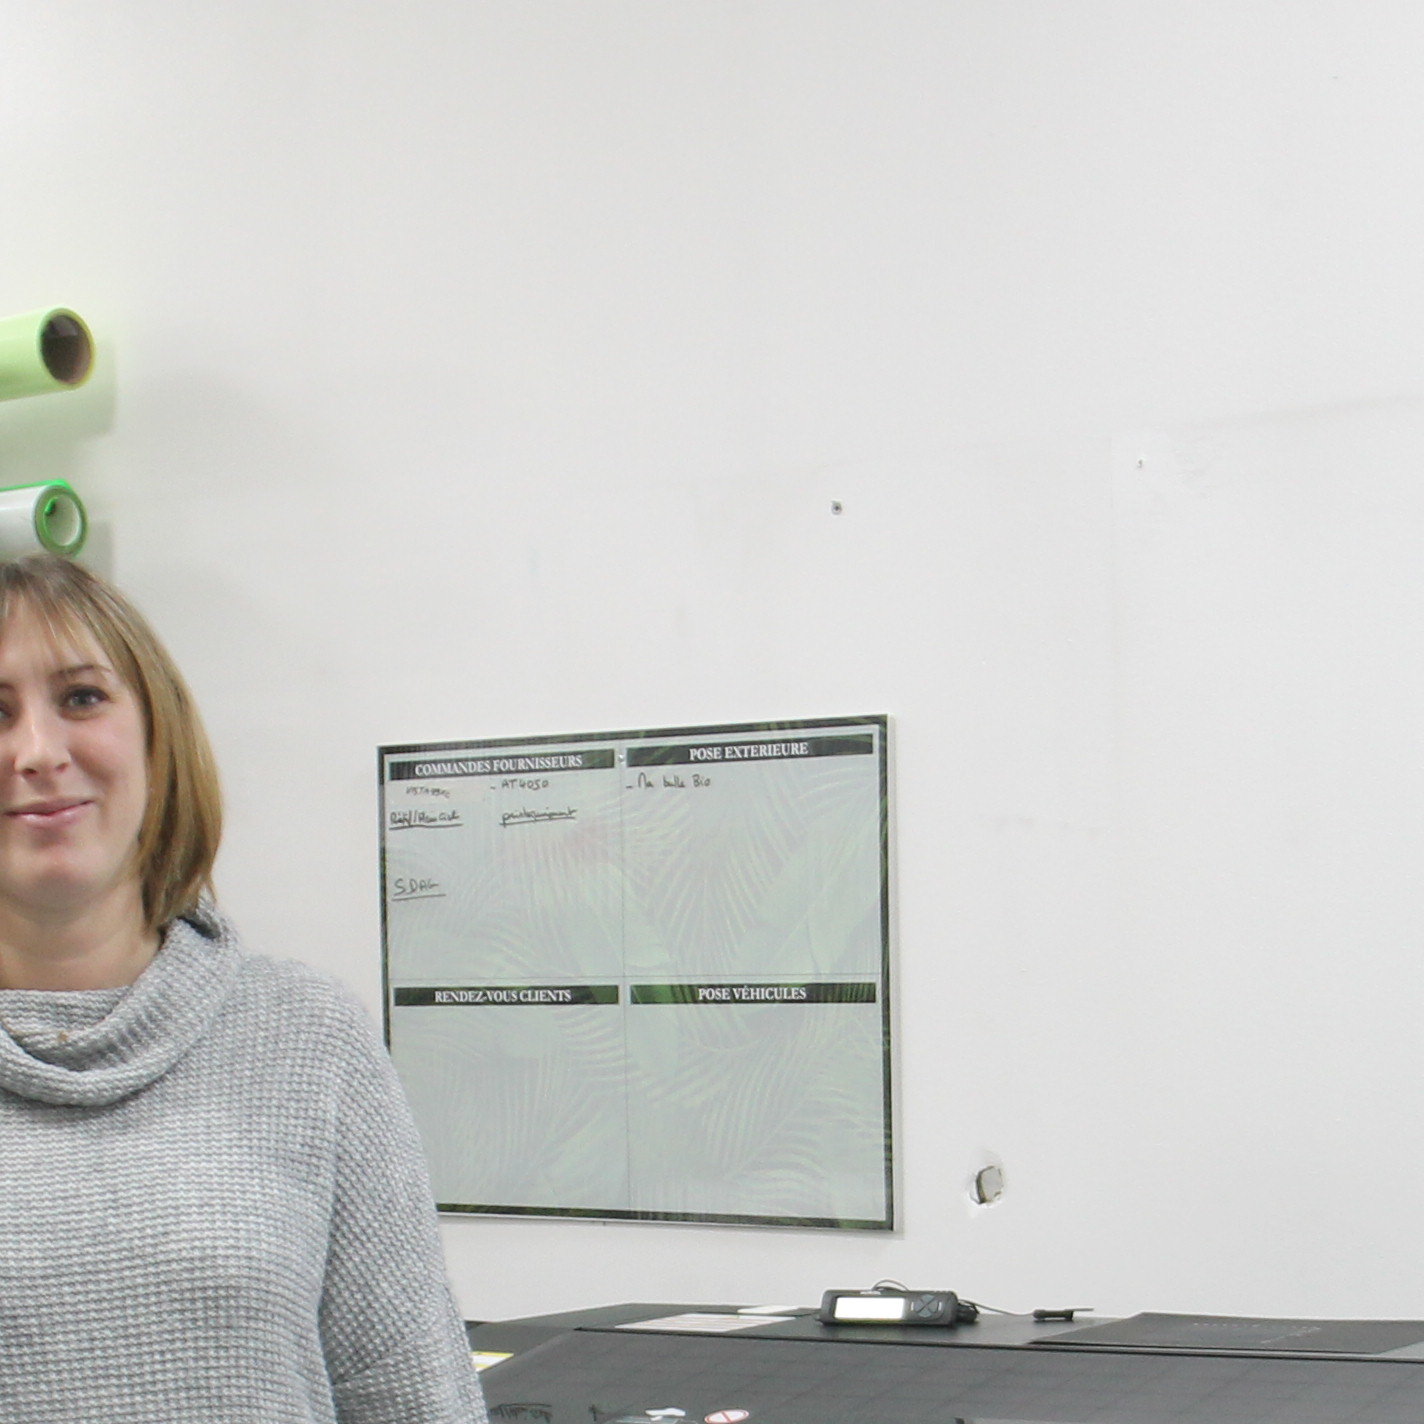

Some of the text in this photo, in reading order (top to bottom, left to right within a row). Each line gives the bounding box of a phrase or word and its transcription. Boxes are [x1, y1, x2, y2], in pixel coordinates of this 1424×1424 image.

[689, 742, 808, 761] POSE EXTERIEURE
[415, 755, 583, 777] COMMANDES FOURNISSEURS
[692, 774, 711, 787] Bio
[434, 988, 572, 1003] RENDEZ-VOUS CLIENTS
[697, 985, 807, 1001] POSE VÉHICULES
